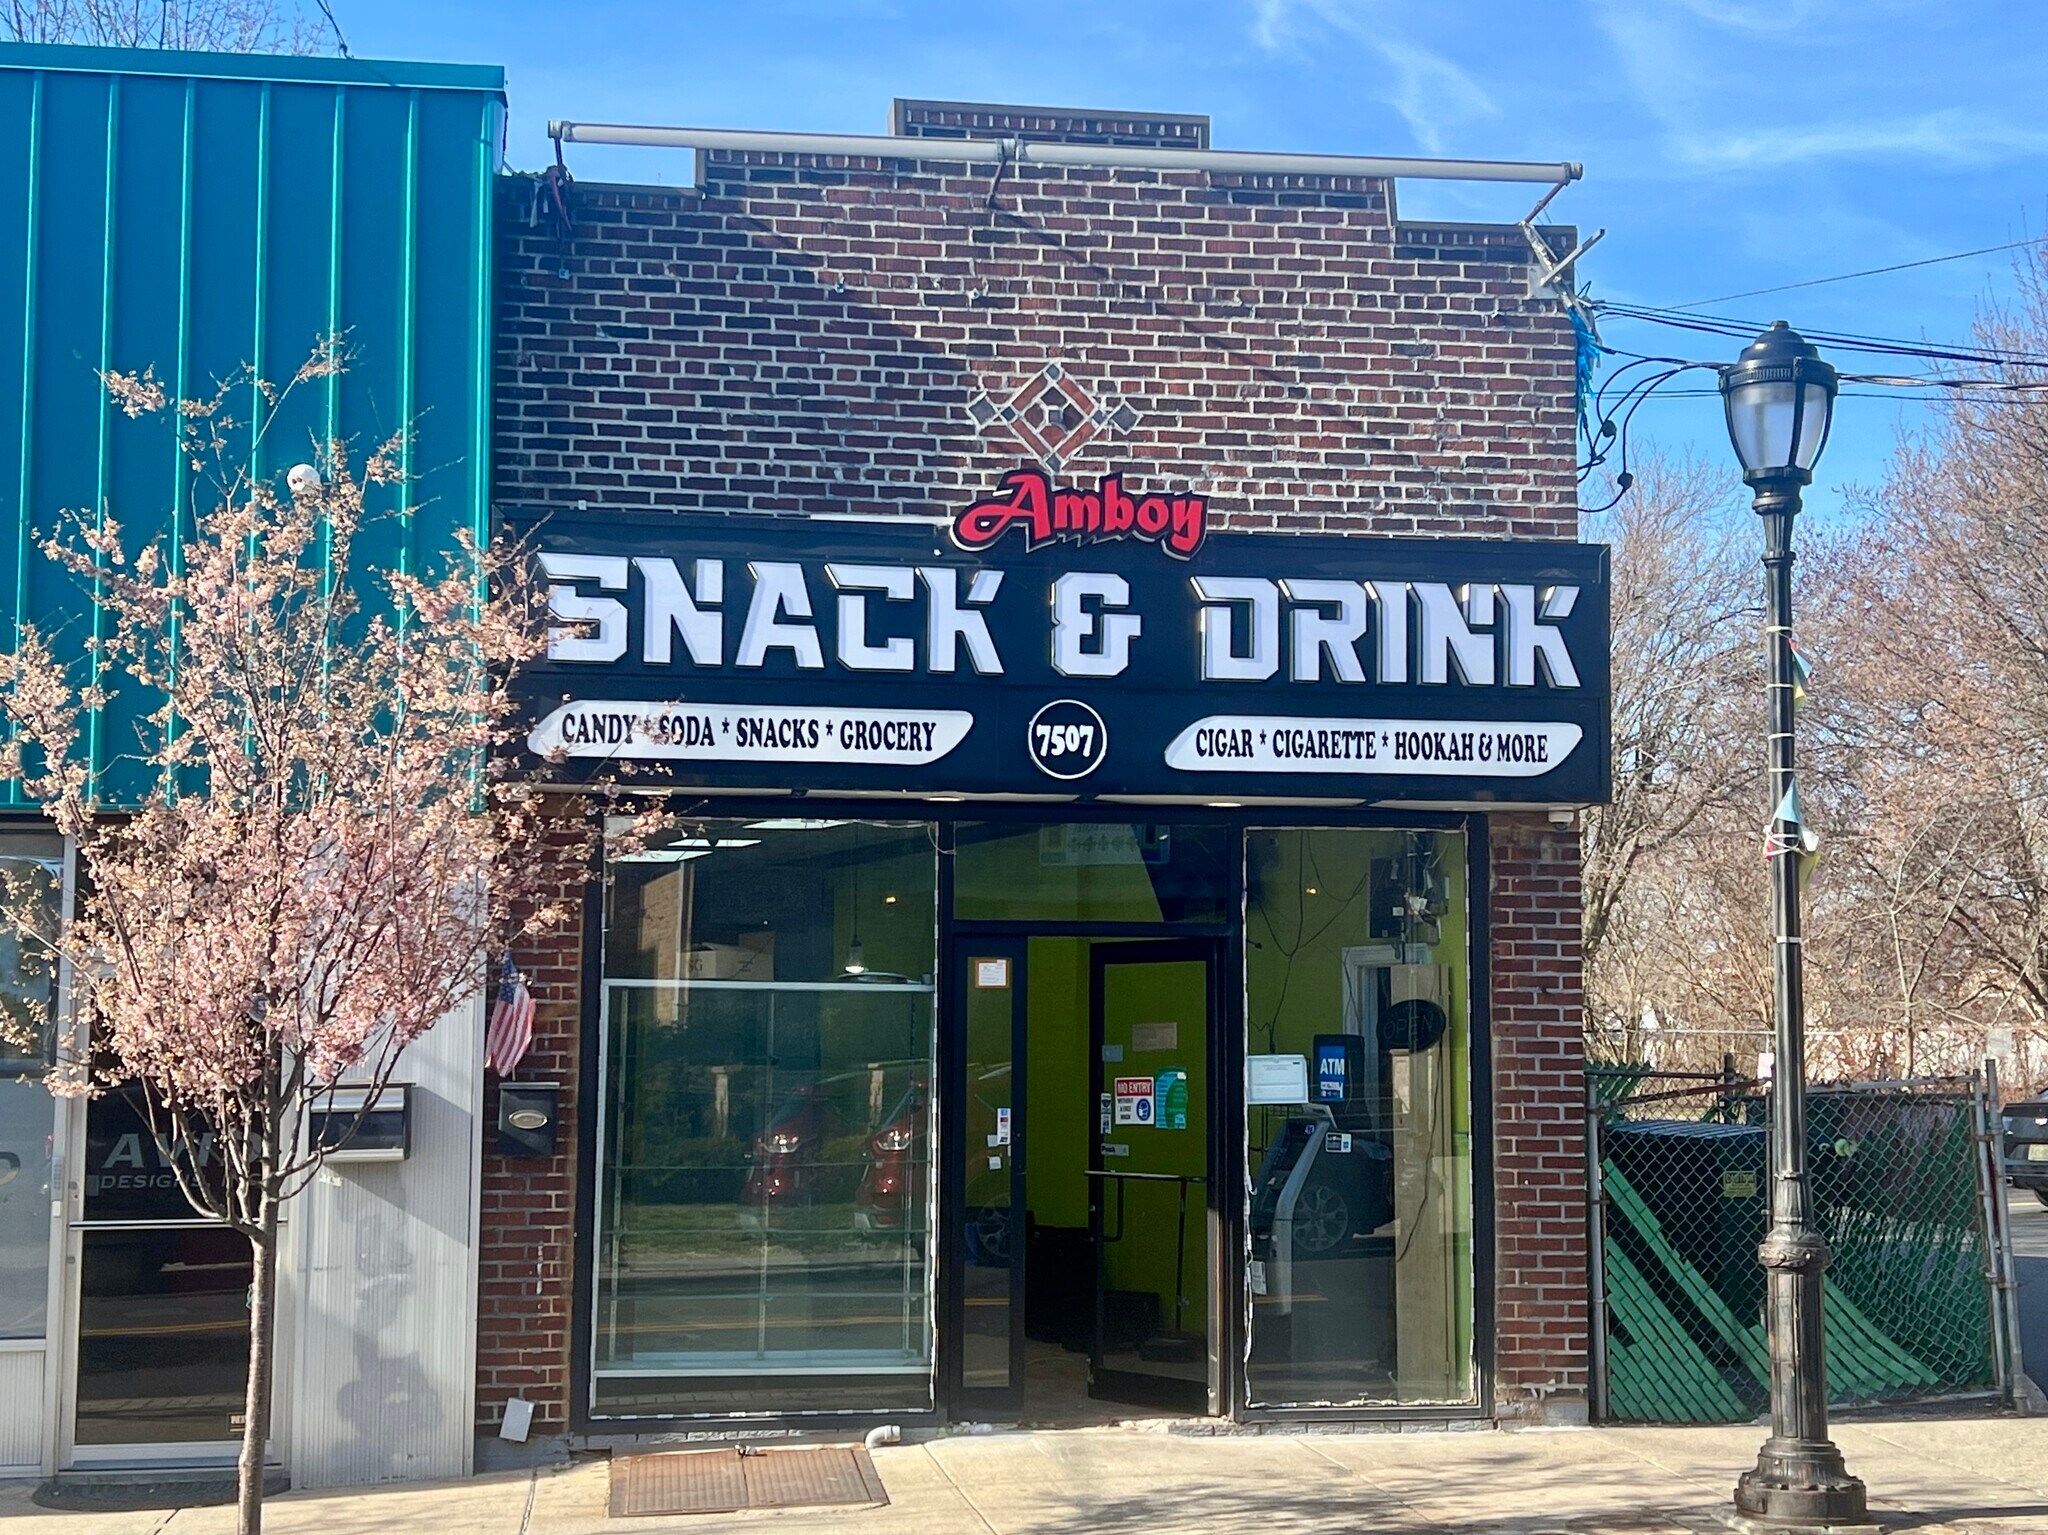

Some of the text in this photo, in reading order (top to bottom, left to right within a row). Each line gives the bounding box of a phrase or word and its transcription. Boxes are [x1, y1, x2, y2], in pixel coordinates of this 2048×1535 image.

[955, 472, 1206, 555] Amboy
[536, 552, 1581, 689] SNACK & DRINK
[562, 713, 937, 752] CANDY SODA SNACKS GROCERY
[1035, 724, 1095, 758] 7507
[1195, 727, 1549, 765] CIGAR CIGARETTE HOOKAH & MORE
[1382, 1014, 1434, 1040] OPEN
[1320, 1058, 1345, 1076] ATM
[1117, 1081, 1152, 1094] NO ENTRY
